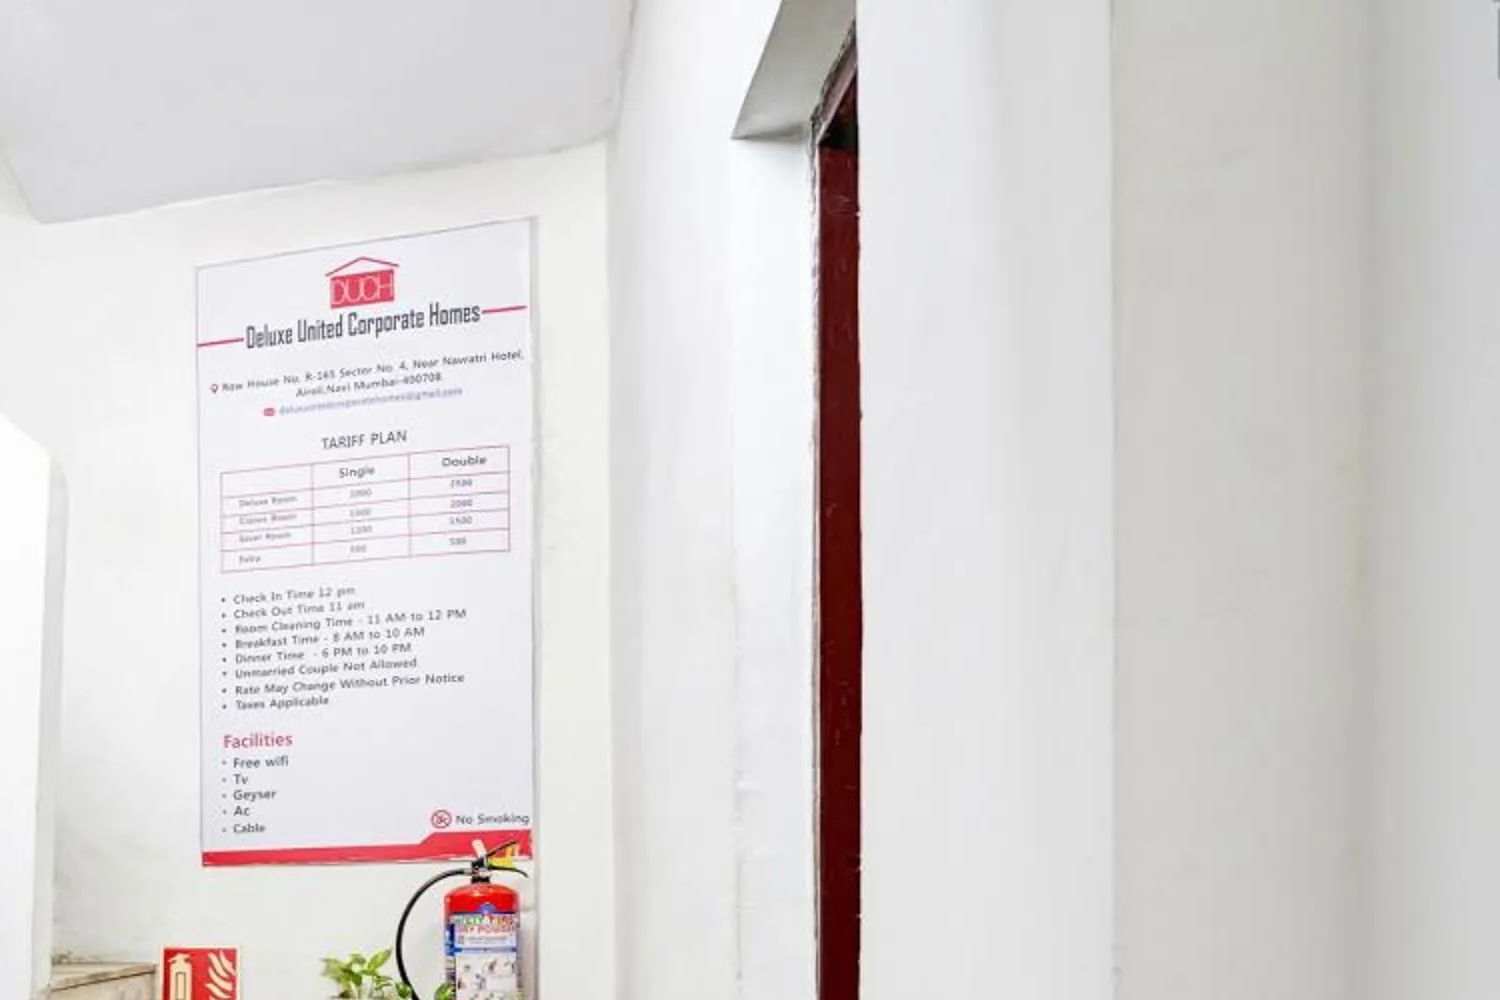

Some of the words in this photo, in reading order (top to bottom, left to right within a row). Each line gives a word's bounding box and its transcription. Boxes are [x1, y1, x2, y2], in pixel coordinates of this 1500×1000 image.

[332, 271, 393, 305] DUCH
[246, 325, 293, 348] Deluxe
[297, 314, 343, 343] United
[348, 308, 425, 338] Corporate
[429, 301, 481, 325] Homes
[247, 377, 280, 389] House
[339, 366, 373, 379] Sector
[413, 359, 439, 370] Near
[443, 352, 487, 366] Navratri
[321, 434, 366, 450] TARIFF
[370, 430, 408, 446] PLAN
[441, 455, 488, 468] Double
[339, 465, 376, 479] Single
[238, 498, 269, 508] Deluxe
[271, 495, 298, 504] Room
[233, 592, 267, 605] Check
[271, 591, 283, 601] In
[286, 589, 315, 600] Time
[319, 586, 334, 598] 12
[337, 587, 356, 598] pm
[233, 607, 267, 619] Check
[271, 606, 293, 617] Out
[297, 603, 325, 614] Time
[329, 602, 342, 612] 11
[348, 601, 365, 611] am
[235, 623, 268, 634] Room
[271, 619, 321, 632] Cleaning
[325, 617, 353, 627] Time
[367, 613, 381, 625] 11
[385, 612, 407, 622] AM
[410, 612, 424, 621] to
[428, 609, 442, 621] 12
[446, 608, 467, 619] PM
[235, 636, 288, 649] Breakfast
[292, 635, 320, 645] Time
[344, 631, 365, 642] AM
[368, 631, 381, 640] to
[386, 627, 401, 639] 10
[404, 626, 425, 638] AM
[235, 652, 272, 664] Dinner
[276, 651, 305, 661] Time
[321, 647, 329, 658] 6
[333, 647, 353, 657] PM
[357, 647, 369, 656] to
[373, 643, 389, 655] 10
[391, 642, 412, 653] PM
[235, 665, 295, 679] Unmarried
[298, 662, 339, 675] Couple
[343, 661, 365, 671] Not
[369, 657, 417, 670] Allowed
[235, 684, 260, 696] Rate
[264, 682, 289, 695] May
[292, 680, 336, 693] Change
[340, 677, 389, 689] Without
[391, 675, 420, 686] Prior
[425, 672, 465, 684] Notice
[236, 698, 265, 710] Taxes
[269, 695, 330, 710] Applicable
[223, 731, 293, 749] Facilities
[233, 757, 261, 769] Free
[265, 755, 289, 767] wifi
[233, 773, 249, 785] Tv
[233, 789, 277, 803] Geyser
[233, 805, 250, 817] Ac
[455, 814, 473, 825] No
[477, 812, 530, 826] Smoking
[233, 823, 266, 834] Cable
